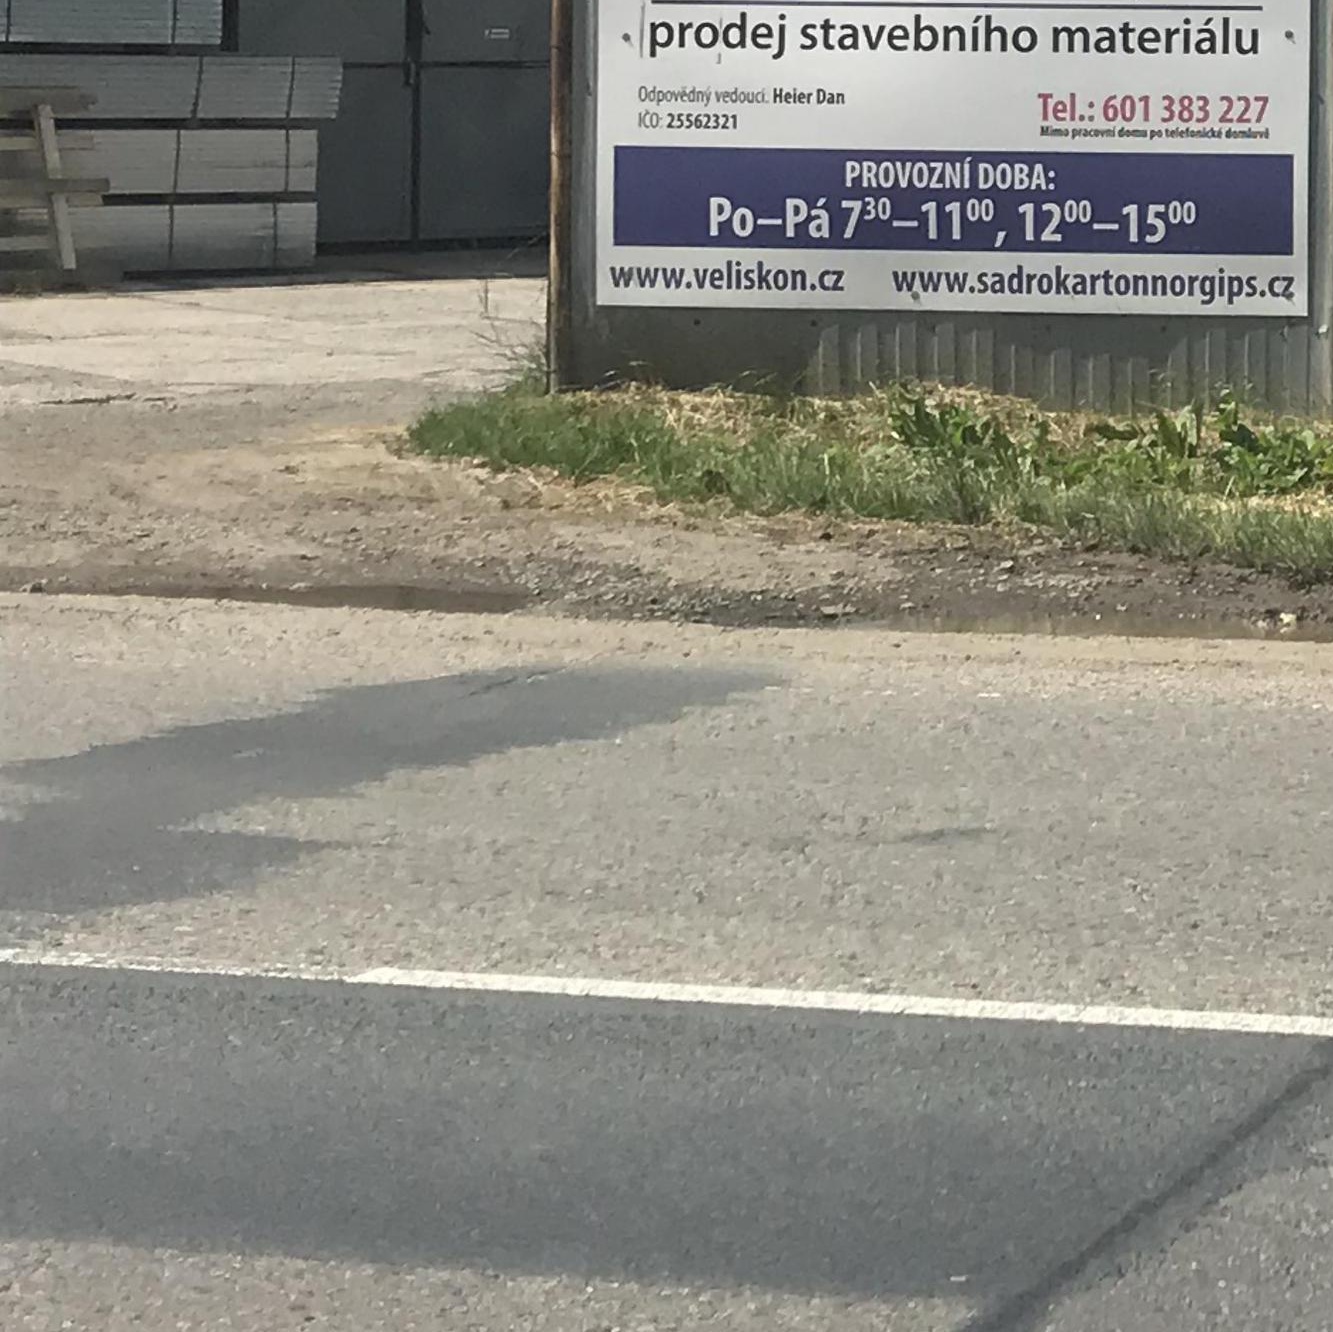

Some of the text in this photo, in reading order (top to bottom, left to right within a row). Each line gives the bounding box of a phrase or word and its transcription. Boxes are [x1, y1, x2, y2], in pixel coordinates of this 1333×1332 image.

[649, 11, 1260, 60] prodej stavebního materiálu
[637, 86, 711, 108] Odpovědný
[772, 88, 814, 104] Heier
[816, 89, 846, 105] Dan
[1037, 93, 1270, 124] Tel.: 601 383 227
[666, 114, 738, 130] 25562321
[1149, 129, 1163, 141] po
[845, 155, 1056, 191] PROVOZNÍ DOBA:
[609, 260, 1296, 306] www.veliskon.cz www.sadrokartonnorgips.cz
